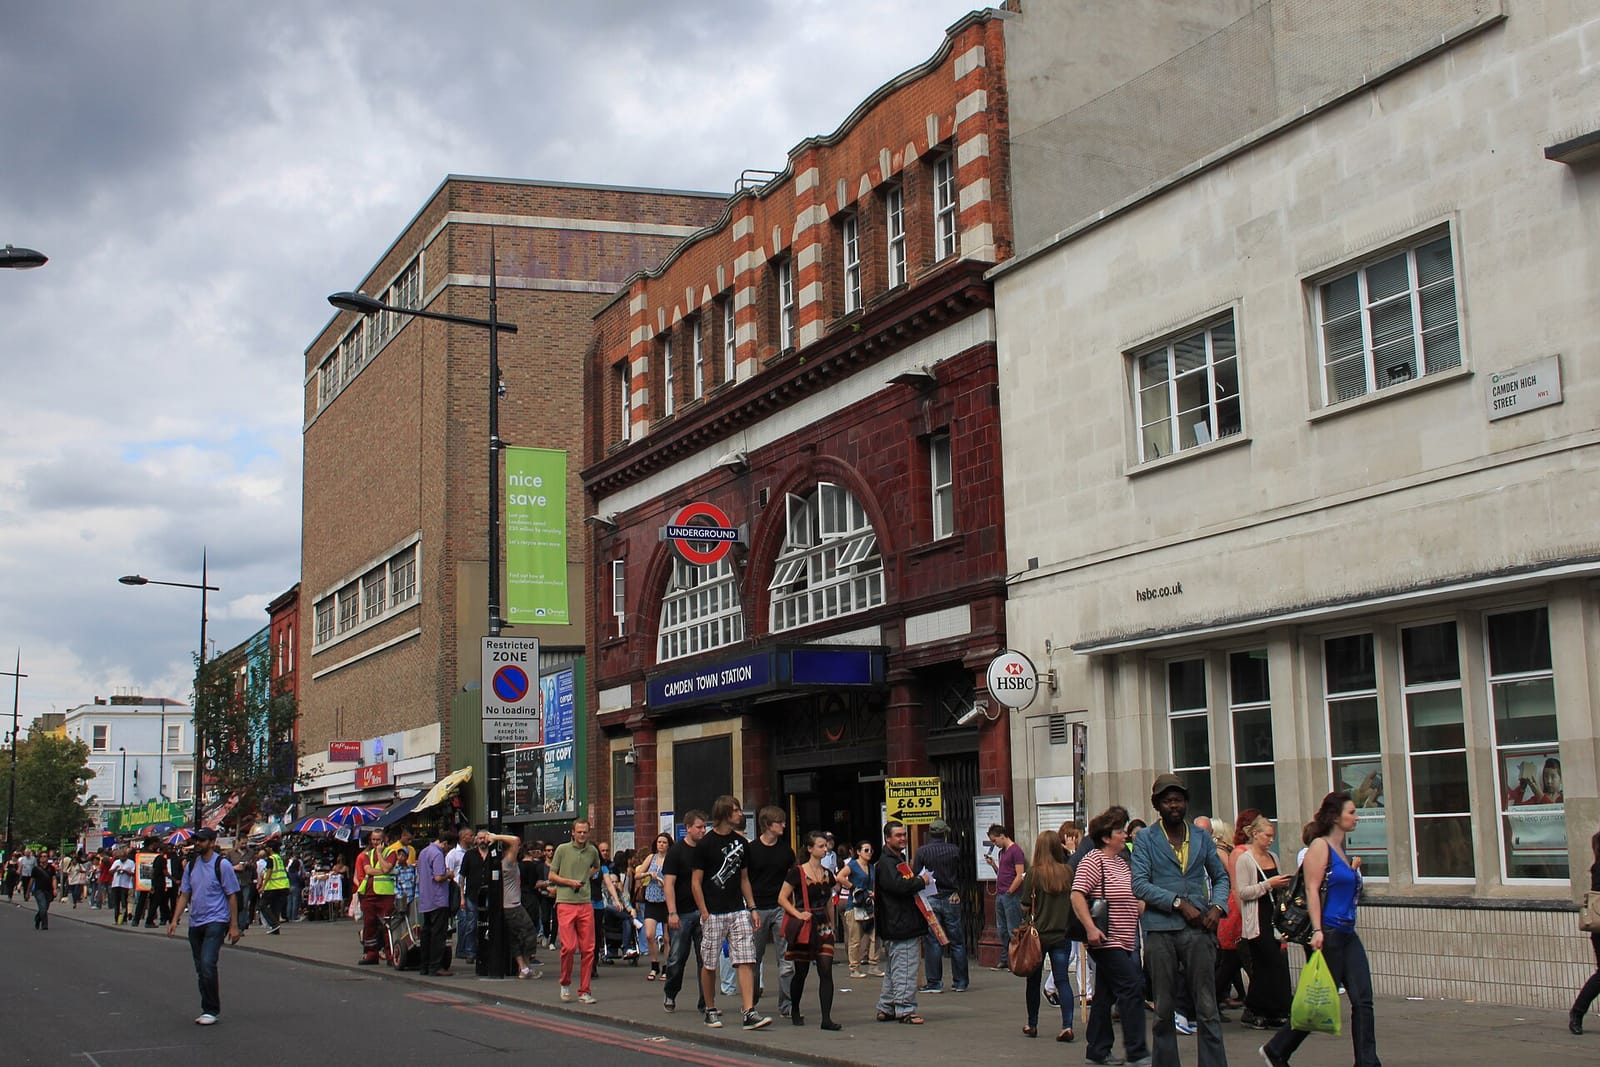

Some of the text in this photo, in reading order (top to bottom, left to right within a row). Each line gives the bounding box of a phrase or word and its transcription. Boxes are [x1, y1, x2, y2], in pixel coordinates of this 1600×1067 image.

[1492, 375, 1537, 397] CAMDEN HIGH
[1537, 390, 1549, 398] NW1
[1493, 395, 1517, 410] STREET
[509, 470, 542, 488] nice
[509, 493, 547, 507] save
[669, 527, 736, 539] UNDERGROUND
[1136, 581, 1183, 602] hsbc.co.uk
[486, 640, 535, 650] Restricted
[492, 651, 528, 662] ZONE
[664, 664, 752, 698] CAMDEN TOWN STATION
[997, 676, 1034, 690] HSBC
[486, 706, 536, 716] No loading
[544, 746, 573, 763] CUT COPY
[890, 787, 938, 797] Indian Buffet
[897, 797, 932, 808] £6.95
